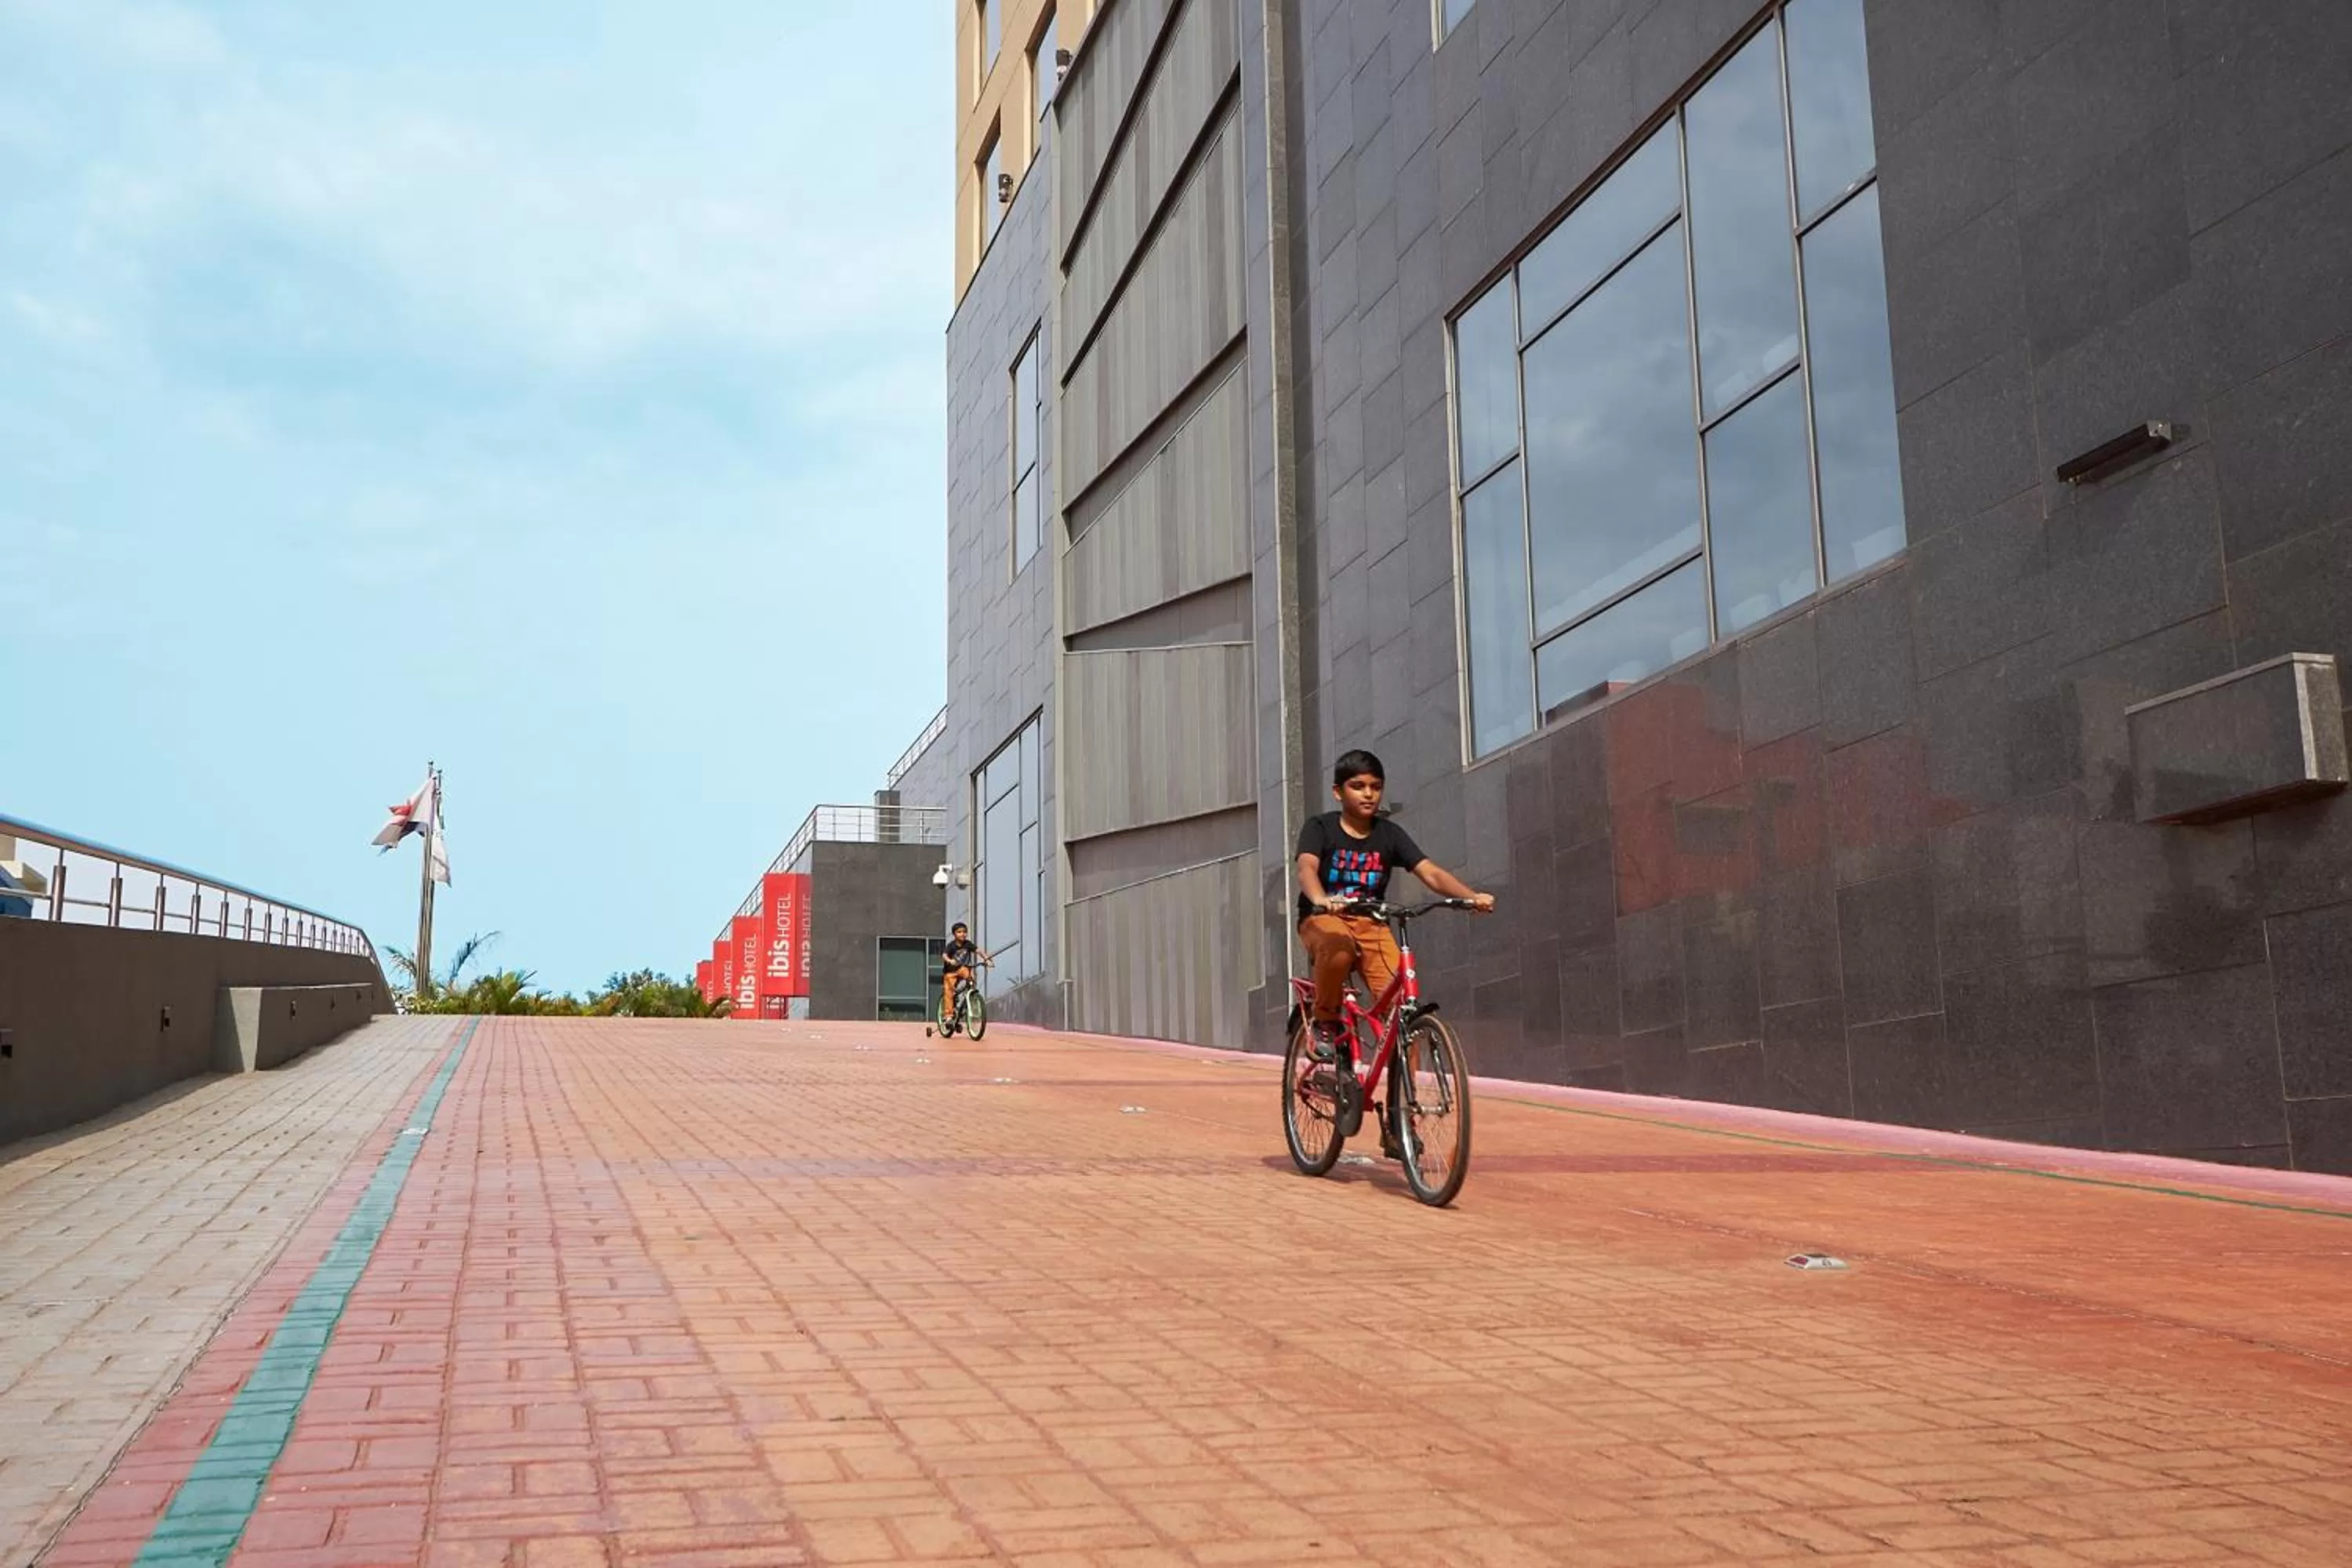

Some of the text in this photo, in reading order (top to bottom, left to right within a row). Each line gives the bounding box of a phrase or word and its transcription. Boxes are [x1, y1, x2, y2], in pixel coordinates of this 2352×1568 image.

[777, 893, 791, 938] HOTEL
[735, 933, 757, 1010] ibis HOTEL
[767, 940, 790, 978] ibis
